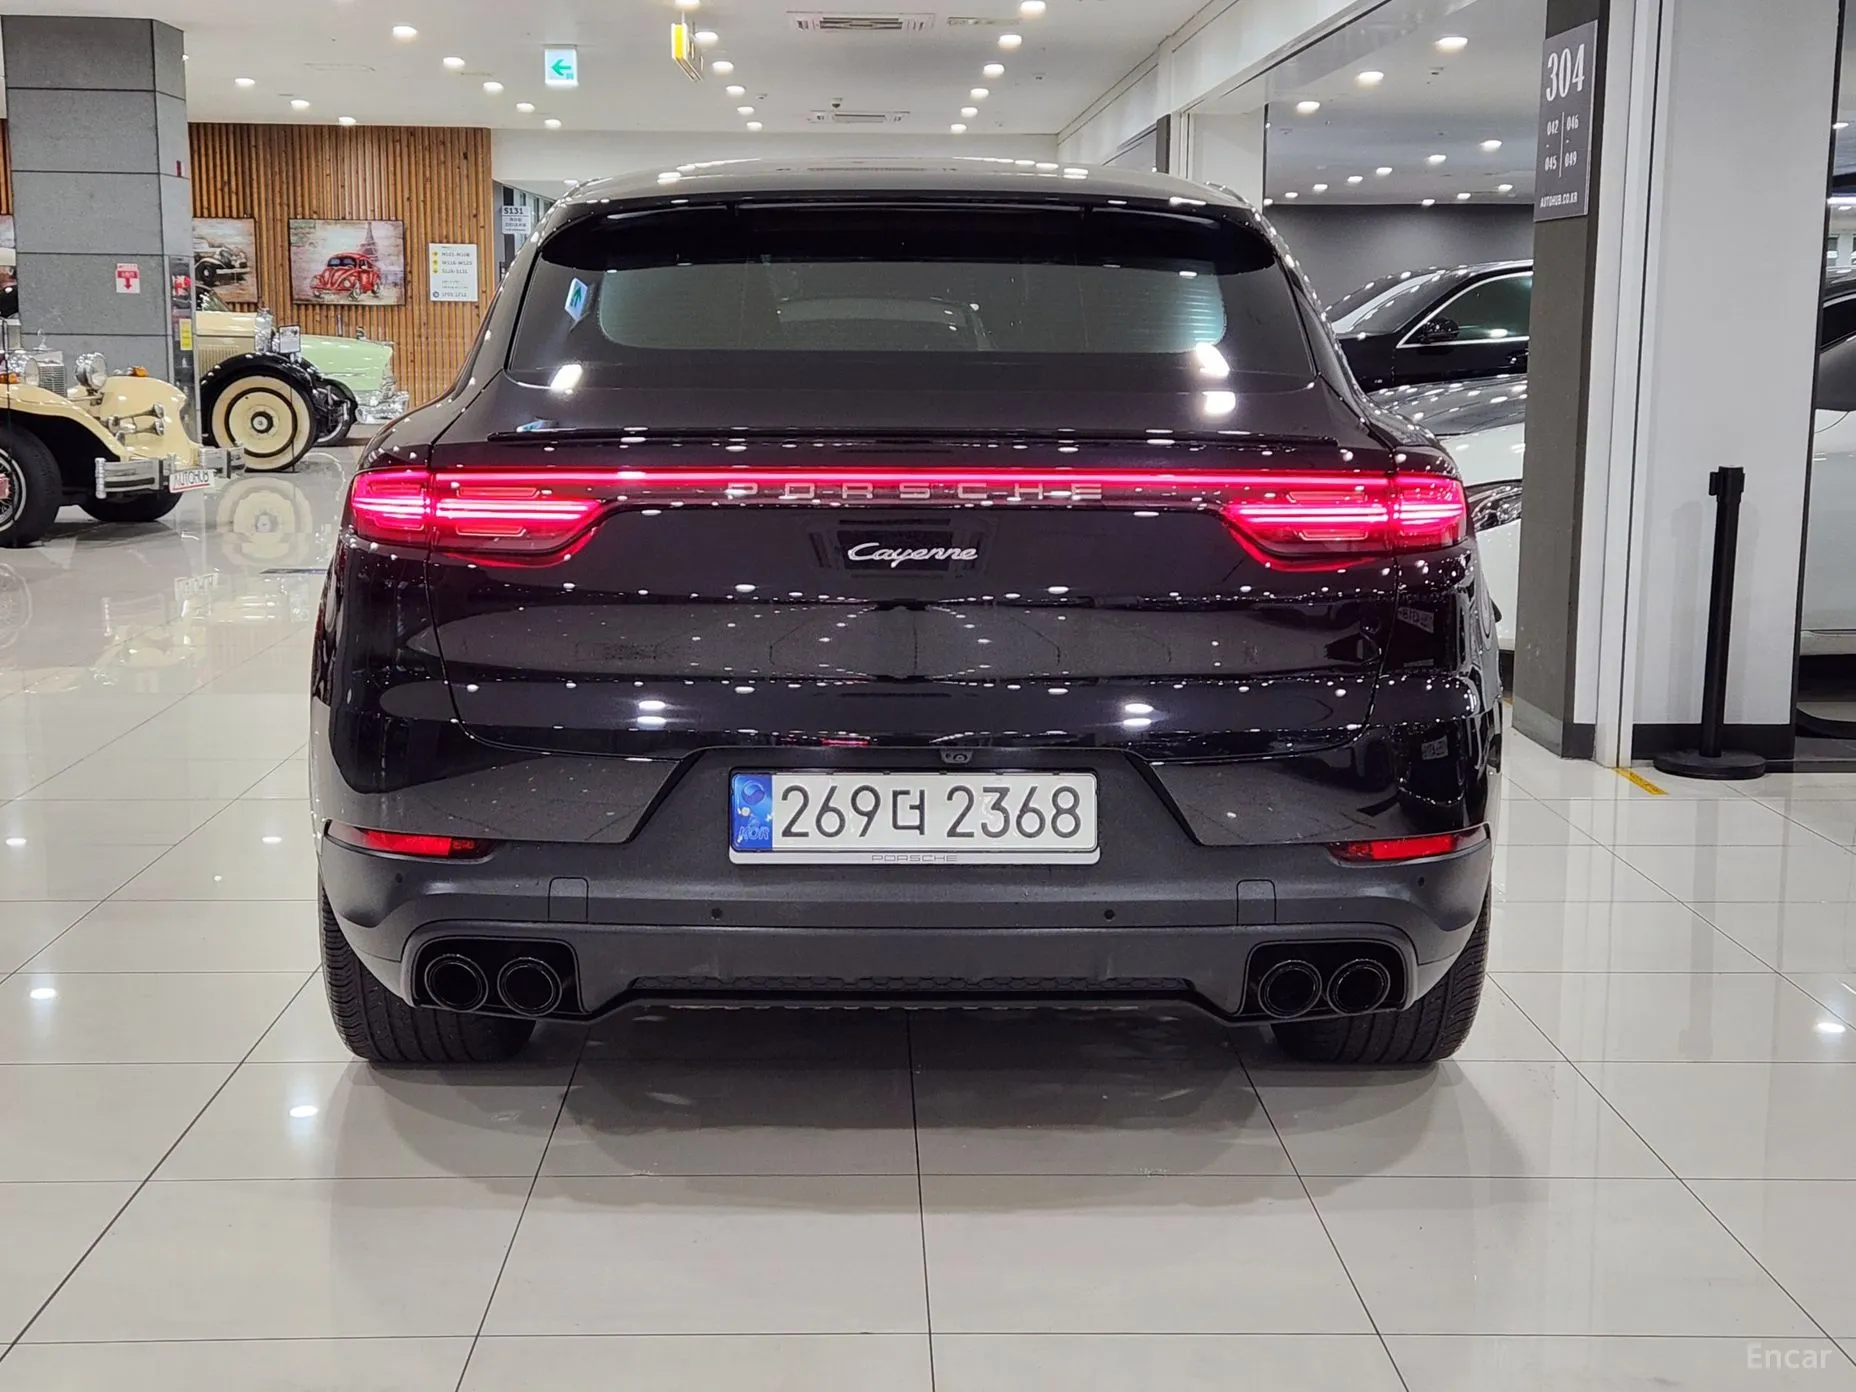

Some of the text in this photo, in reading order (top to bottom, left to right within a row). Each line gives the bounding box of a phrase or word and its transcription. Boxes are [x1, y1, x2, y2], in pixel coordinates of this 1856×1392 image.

[1545, 44, 1585, 101] 304
[1546, 120, 1559, 136] 042
[1539, 192, 1578, 208] AUTOHUB.CO.KR
[503, 207, 524, 215] S131
[727, 482, 1102, 501] PORSCHE
[847, 542, 978, 568] Cayenne
[780, 784, 1082, 839] 269더 2368
[871, 854, 958, 863] PORSCHE
